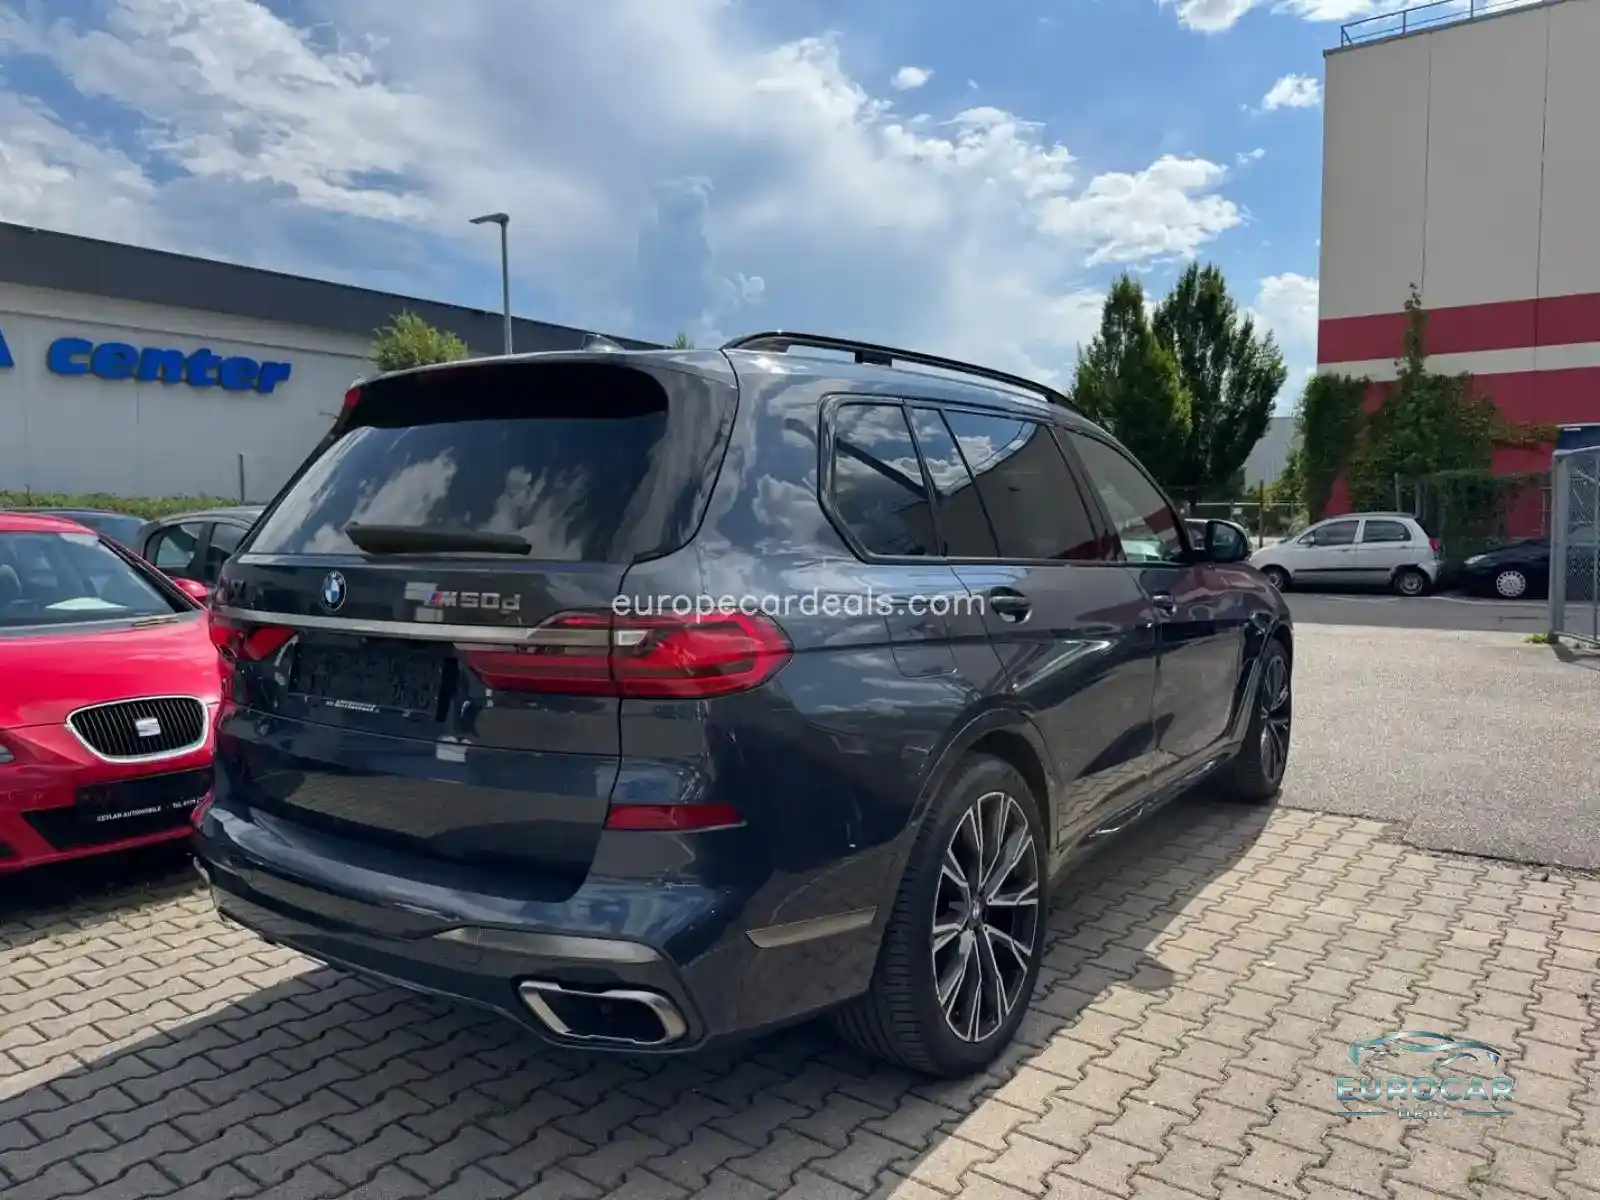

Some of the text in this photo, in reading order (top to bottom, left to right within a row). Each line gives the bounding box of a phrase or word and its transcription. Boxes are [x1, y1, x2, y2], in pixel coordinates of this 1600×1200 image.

[47, 337, 292, 394] center
[432, 590, 521, 611] M50d
[122, 805, 162, 818] AUTOMOBILE
